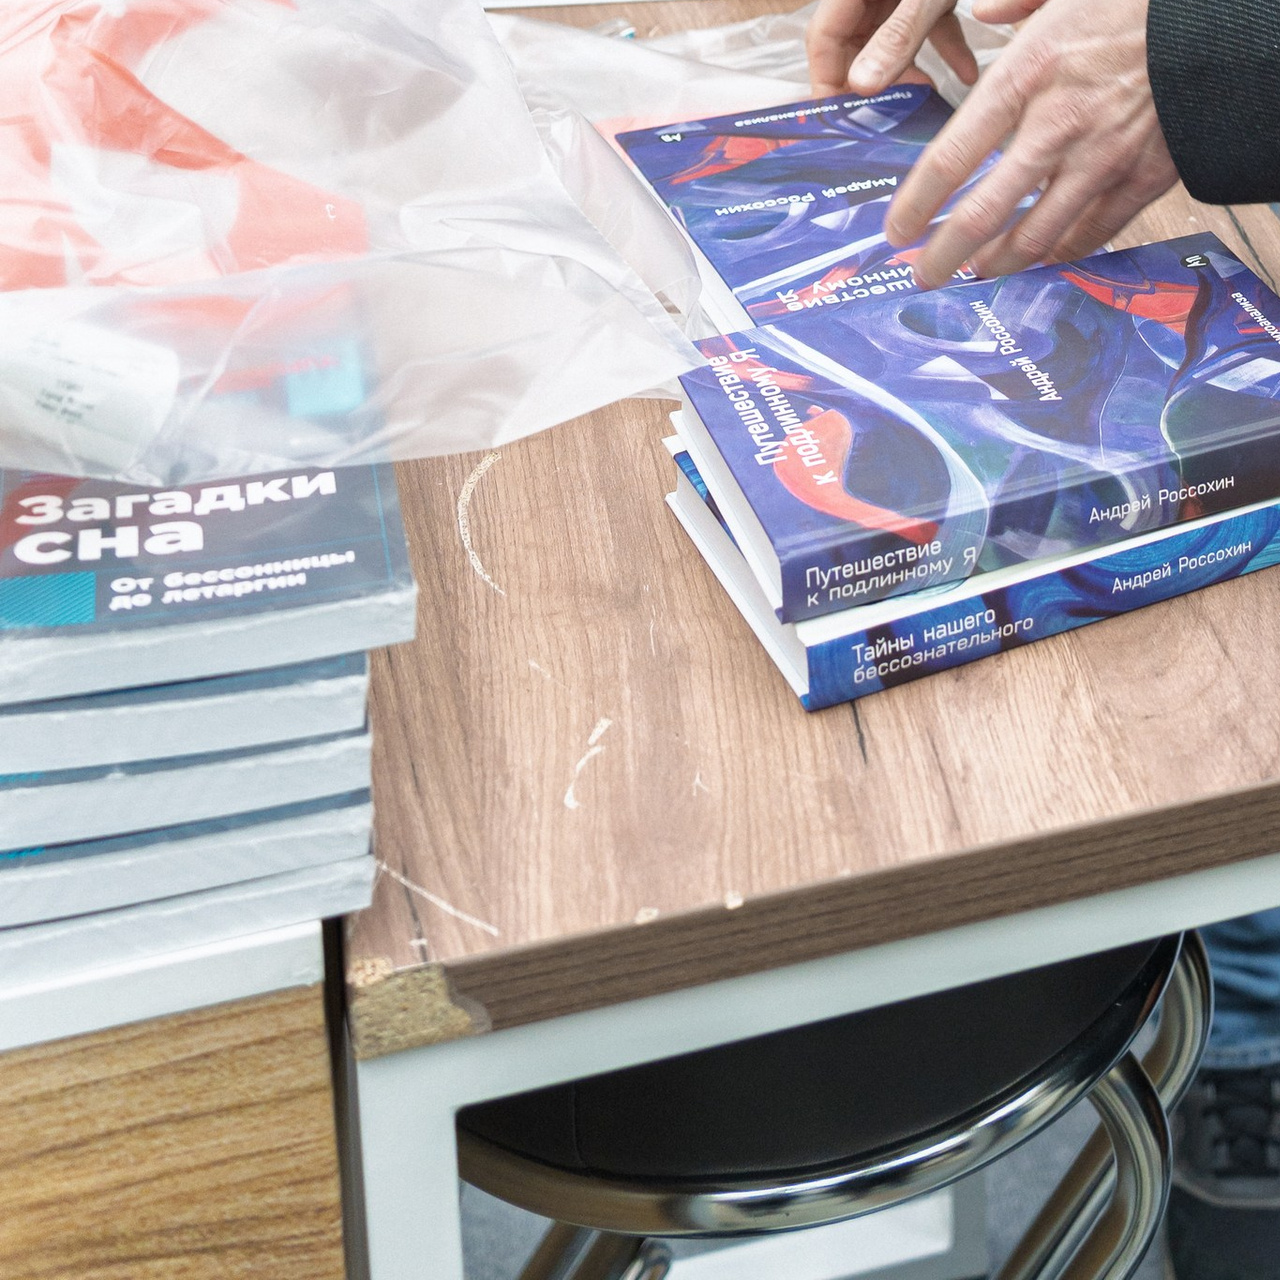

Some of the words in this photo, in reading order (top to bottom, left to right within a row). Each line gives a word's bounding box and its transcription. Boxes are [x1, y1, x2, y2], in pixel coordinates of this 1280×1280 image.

[734, 103, 839, 128] психоанализа
[842, 90, 914, 109] Практика
[715, 192, 816, 216] Россохин
[821, 175, 898, 199] Андрей
[775, 288, 799, 304] Я
[969, 300, 1021, 357] Россохин
[730, 347, 760, 362] Я
[1009, 351, 1063, 402] Андрей
[708, 355, 788, 466] Путешествие
[746, 366, 826, 466] подлинному
[14, 471, 338, 526] Загадки
[1089, 494, 1151, 524] Андрей
[1158, 475, 1235, 506] Россохин
[13, 520, 205, 565] сна
[805, 539, 942, 589] Путешествие
[1112, 563, 1172, 594] Андрей
[1178, 540, 1252, 573] Россохин
[109, 592, 153, 612] до
[162, 572, 307, 605] летаргии
[110, 576, 155, 593] От
[163, 550, 356, 588] бессонницы
[828, 557, 954, 601] подлинному
[962, 547, 977, 566] Я
[851, 633, 914, 665] Тайны
[923, 607, 996, 641] нашего
[853, 616, 1034, 684] бессознательного
